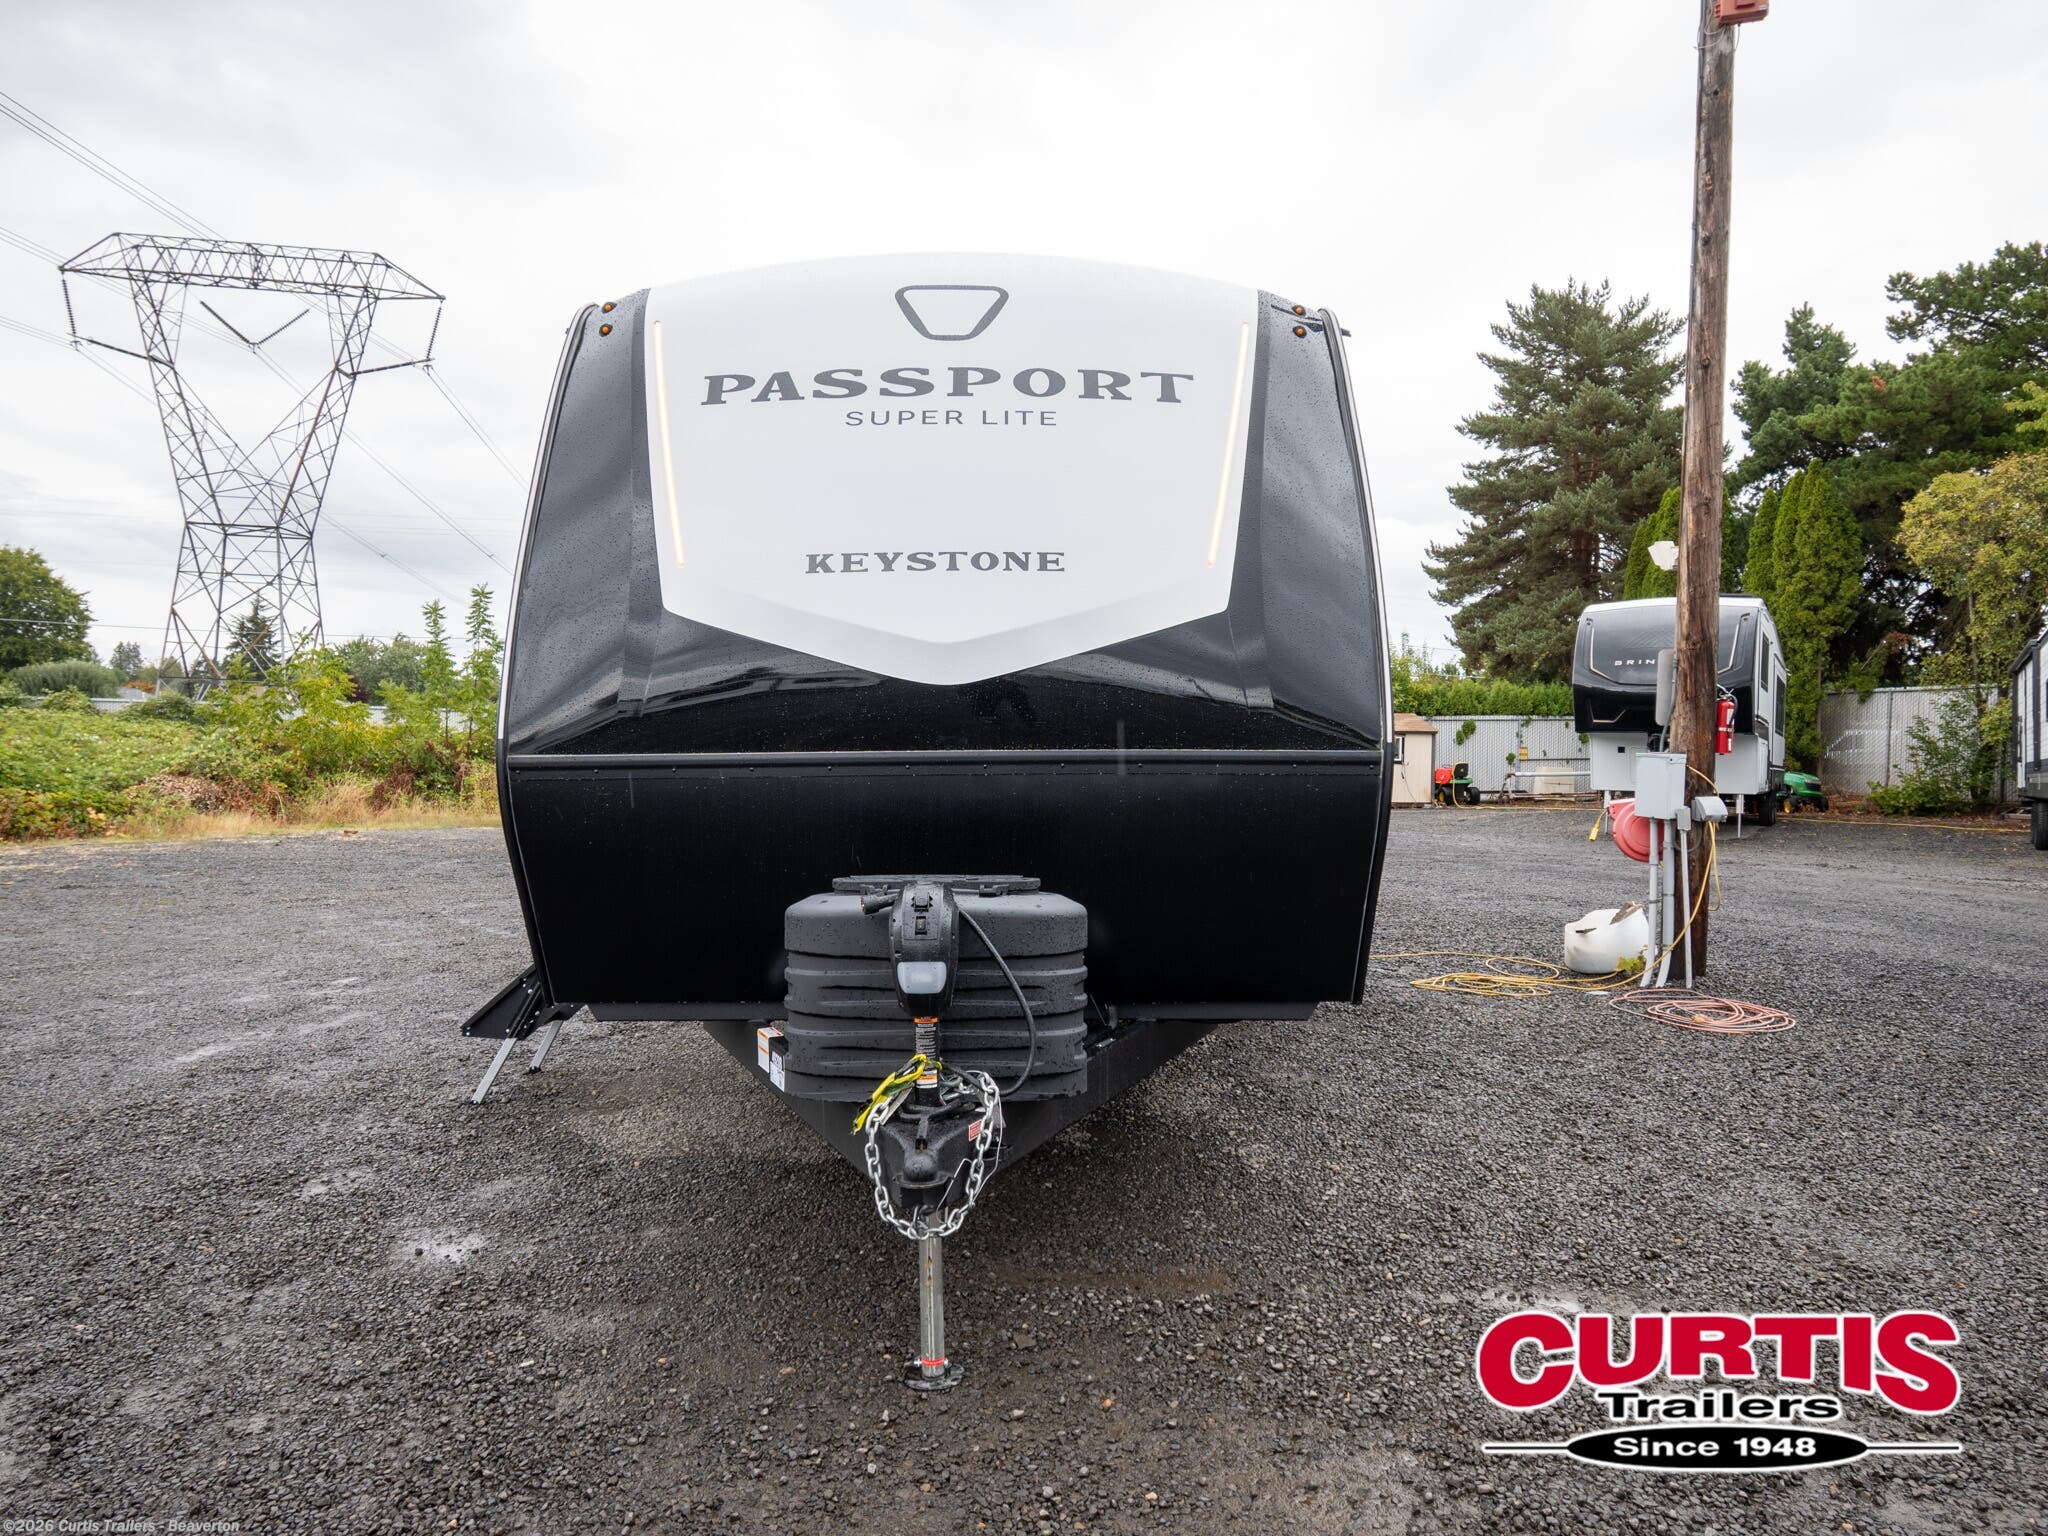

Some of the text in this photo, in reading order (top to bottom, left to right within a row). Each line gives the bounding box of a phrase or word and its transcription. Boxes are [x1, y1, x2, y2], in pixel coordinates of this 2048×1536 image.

[700, 366, 1194, 406] PASSPORT
[845, 410, 1058, 427] SUPER LITE
[805, 551, 1066, 575] KEYSTONE
